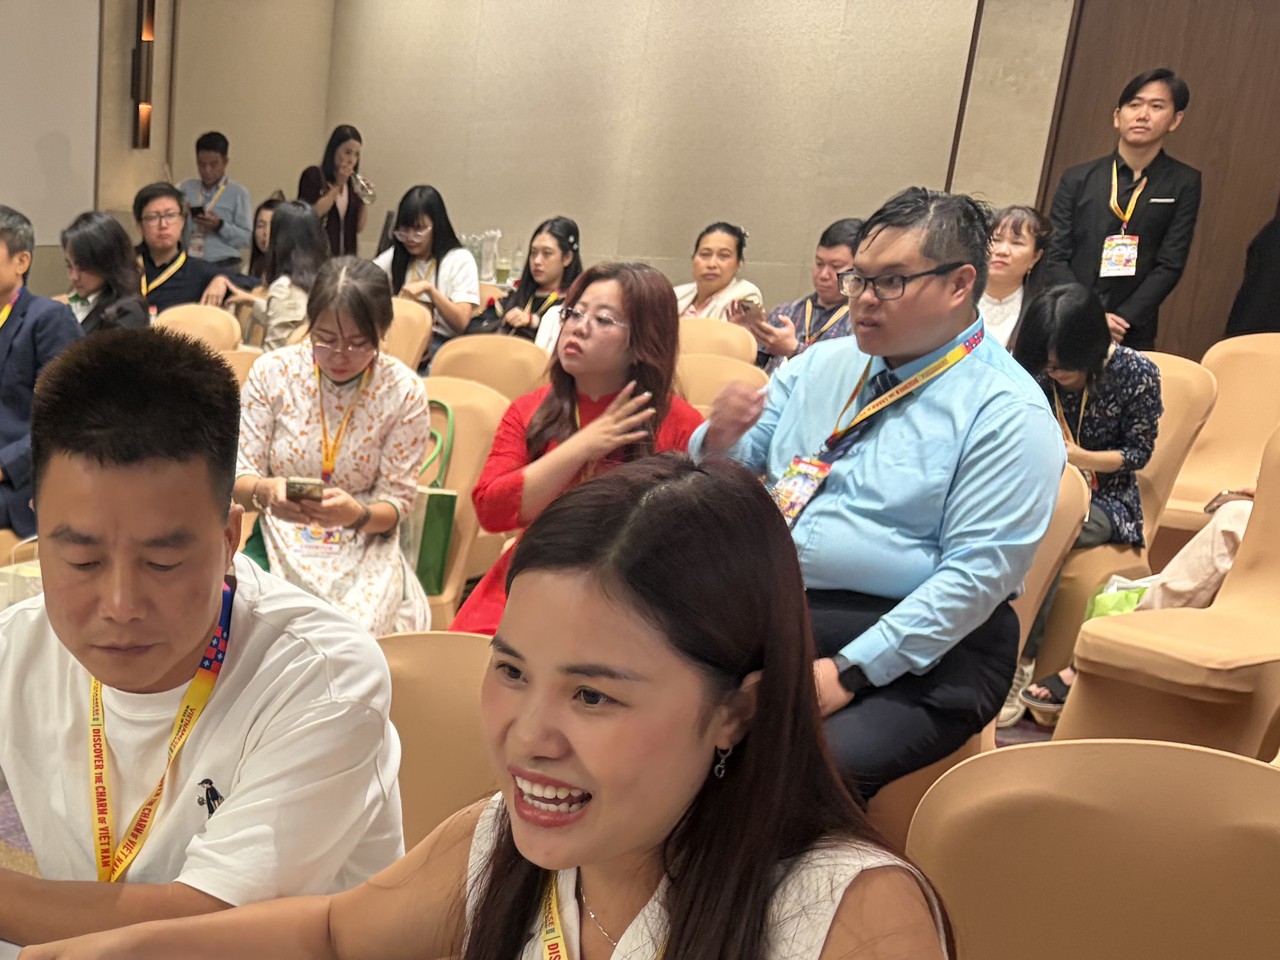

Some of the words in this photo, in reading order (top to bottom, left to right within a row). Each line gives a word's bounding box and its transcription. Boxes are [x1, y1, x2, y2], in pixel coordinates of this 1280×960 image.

[91, 728, 104, 769] DISCOVER
[94, 772, 103, 783] THE
[95, 786, 107, 815] CHARM
[97, 816, 107, 824] OF
[132, 805, 153, 834] CHARM
[100, 847, 111, 867] NAM
